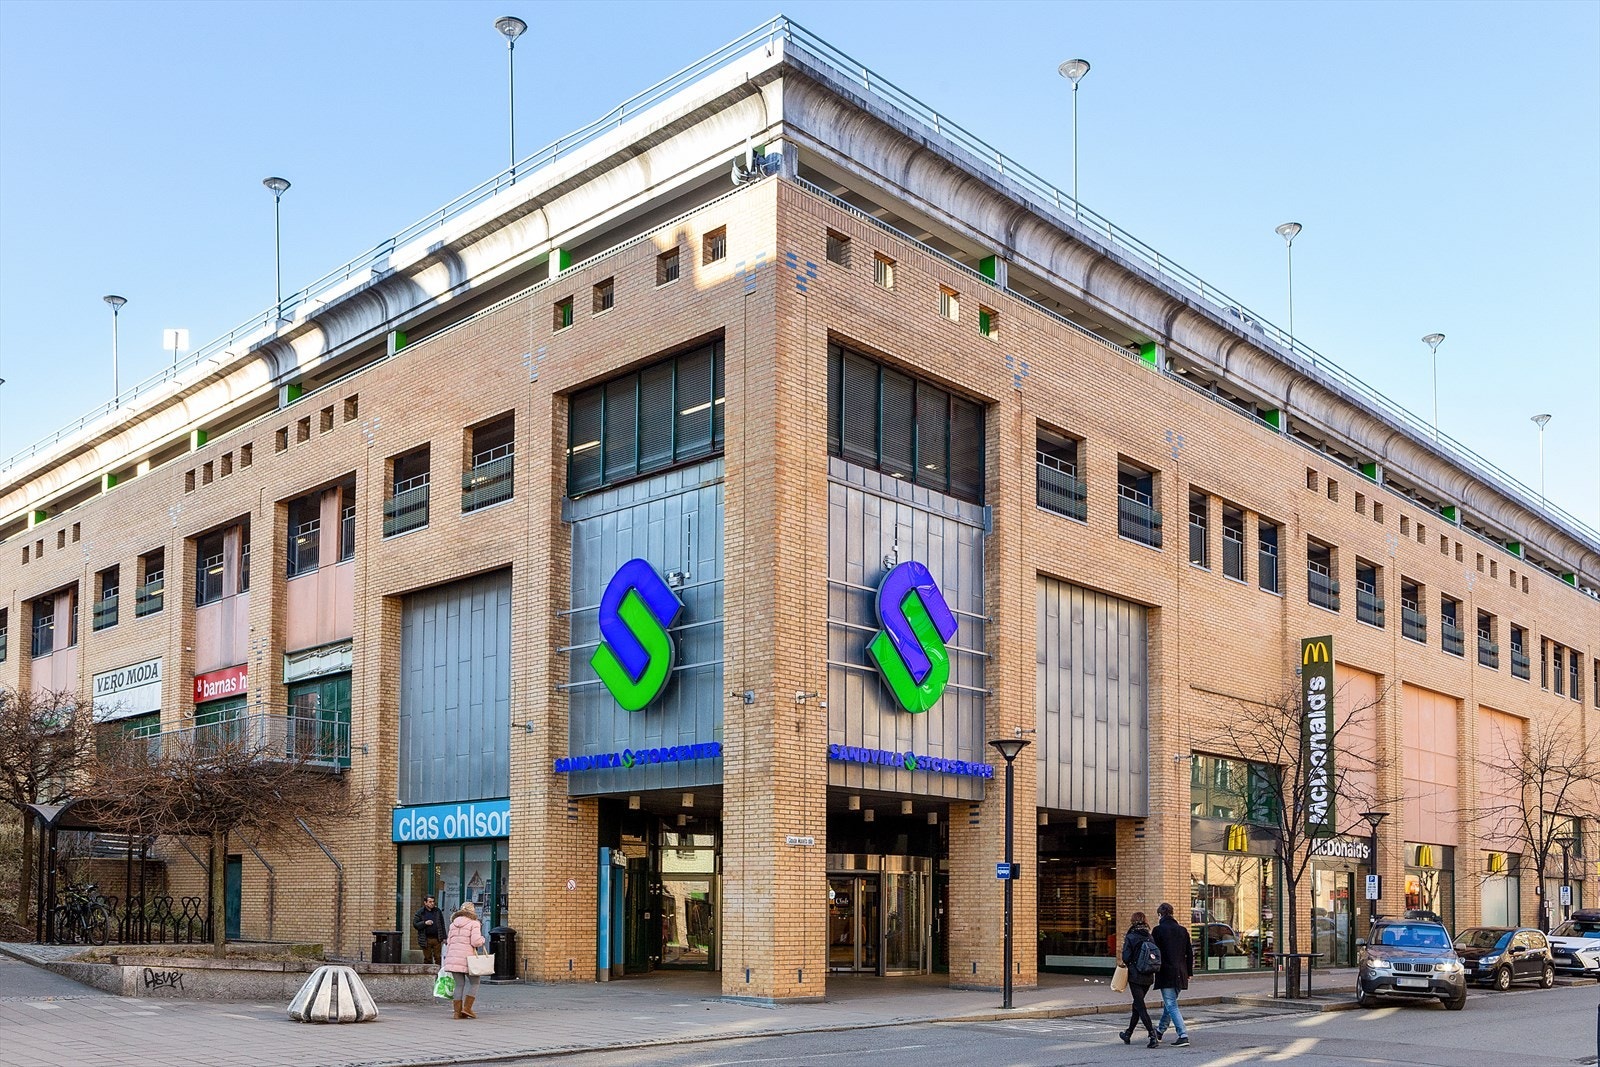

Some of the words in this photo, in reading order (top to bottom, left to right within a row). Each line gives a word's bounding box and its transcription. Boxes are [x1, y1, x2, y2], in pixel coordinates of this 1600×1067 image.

[97, 674, 124, 693] VERO
[126, 663, 159, 684] MODA
[203, 676, 236, 697] barnas
[555, 753, 621, 773] SANDVIKA
[635, 742, 723, 765] STORSENTER
[828, 744, 904, 768] SANDVIKA
[916, 755, 994, 779] STORSENTER
[1307, 675, 1328, 825] McDonald's
[399, 809, 439, 841] clas
[1309, 837, 1369, 859] McDonald's
